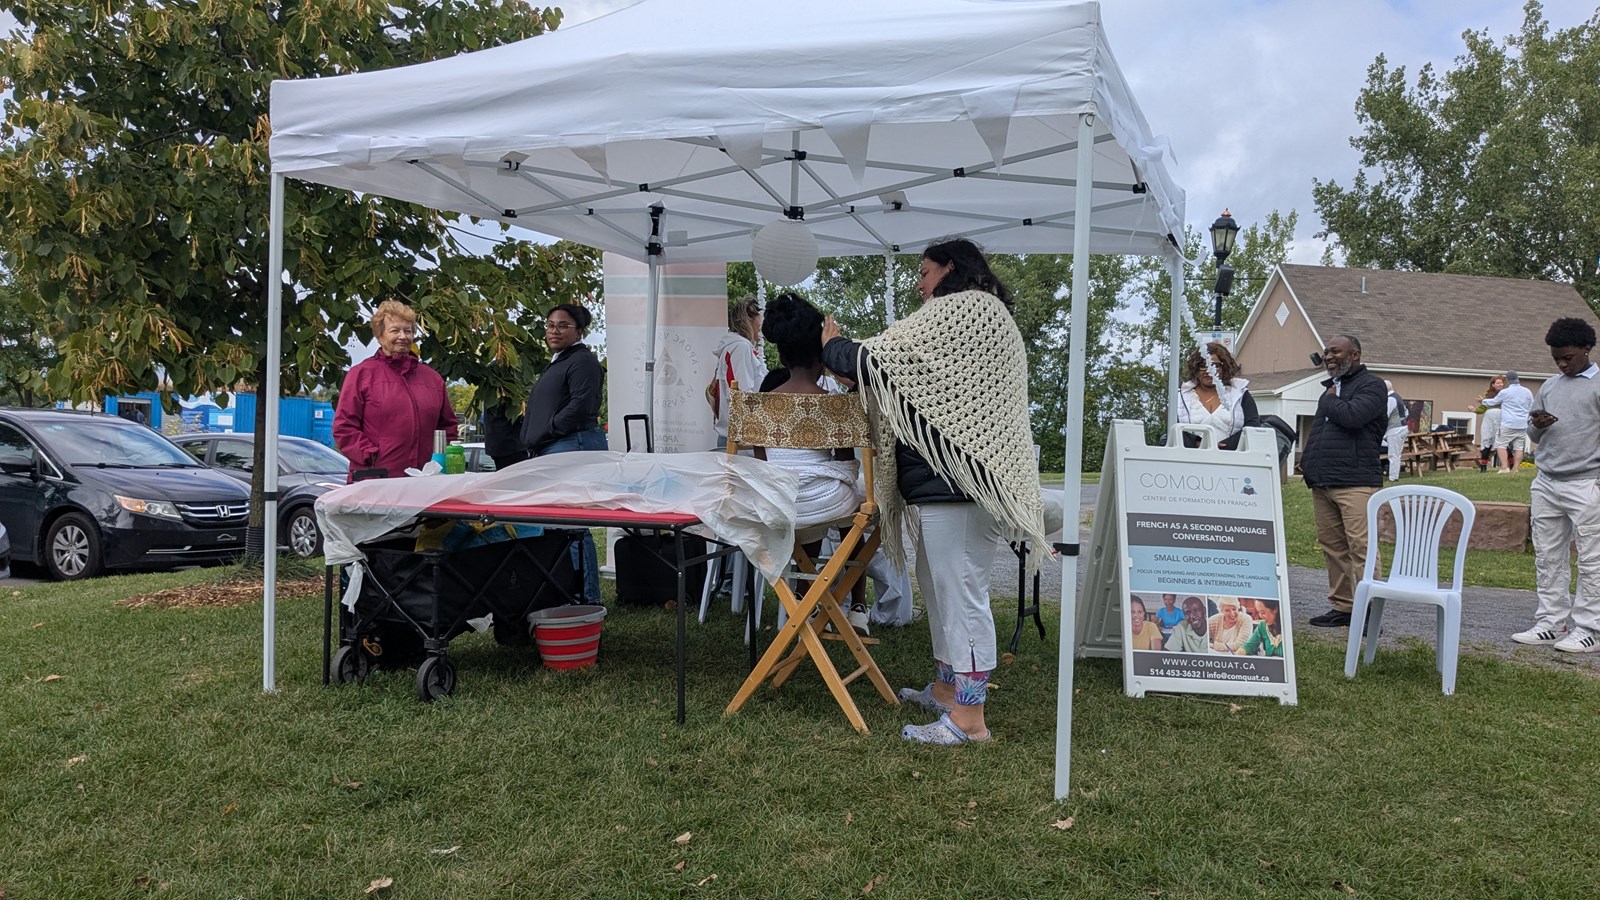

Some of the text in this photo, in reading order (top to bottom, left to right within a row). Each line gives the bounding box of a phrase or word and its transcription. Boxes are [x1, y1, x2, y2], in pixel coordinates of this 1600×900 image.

[1140, 472, 1238, 493] COMQUAT
[1190, 524, 1223, 532] SECOND
[1224, 526, 1267, 535] LANGUAGE
[1172, 533, 1234, 543] CONVERSATION
[1154, 554, 1250, 566] SMALL GROUP COURSES
[1204, 580, 1252, 588] INTERMEDIATE
[1162, 658, 1256, 670] WWW.COMQUAT.CA
[1166, 670, 1201, 678] 453-3632
[1207, 672, 1269, 682] info@comquat.ca
